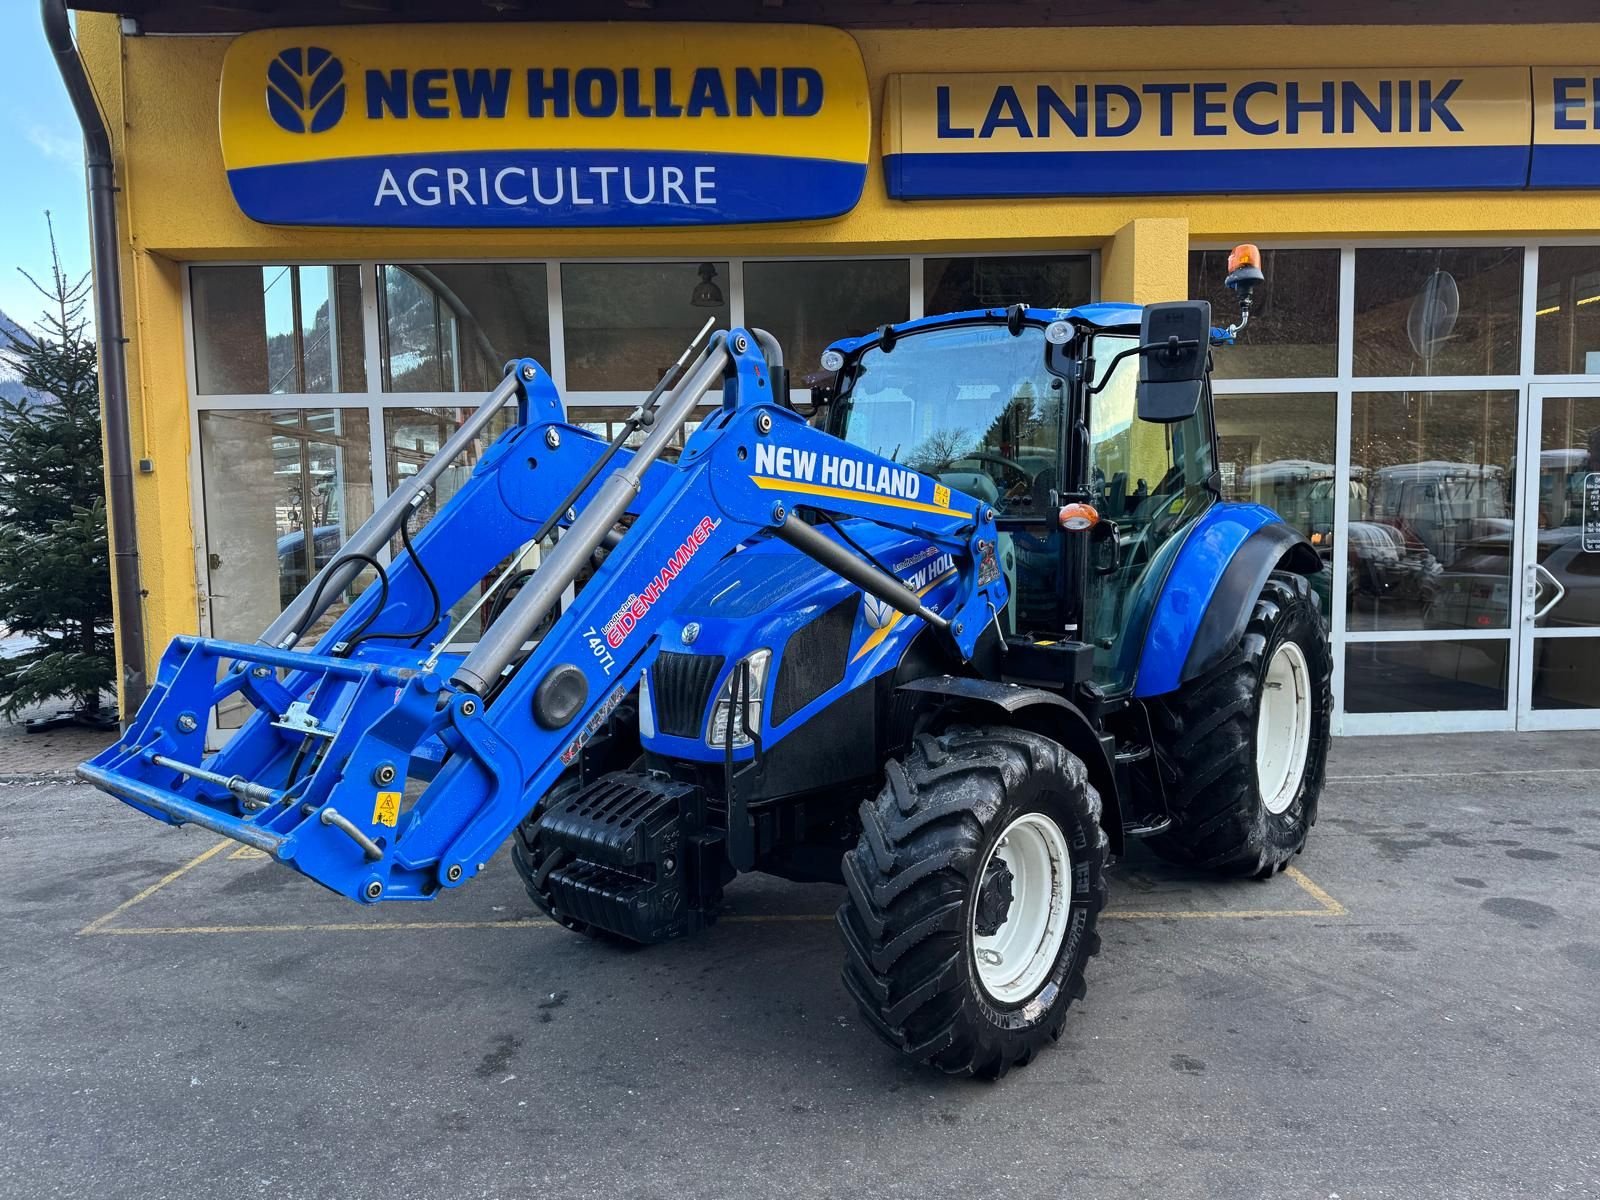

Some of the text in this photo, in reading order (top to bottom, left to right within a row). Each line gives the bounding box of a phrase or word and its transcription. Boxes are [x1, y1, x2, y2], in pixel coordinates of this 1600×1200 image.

[365, 66, 824, 119] NEW HOLLAND
[936, 79, 1464, 139] LANDTECHNIK
[374, 166, 717, 207] AGRICULTURE
[755, 442, 920, 500] NEW HOLLAND
[606, 516, 715, 648] EIDENHAMMER
[928, 553, 954, 581] HOLL
[601, 593, 637, 634] Landtechnik
[582, 625, 616, 676] 740TL
